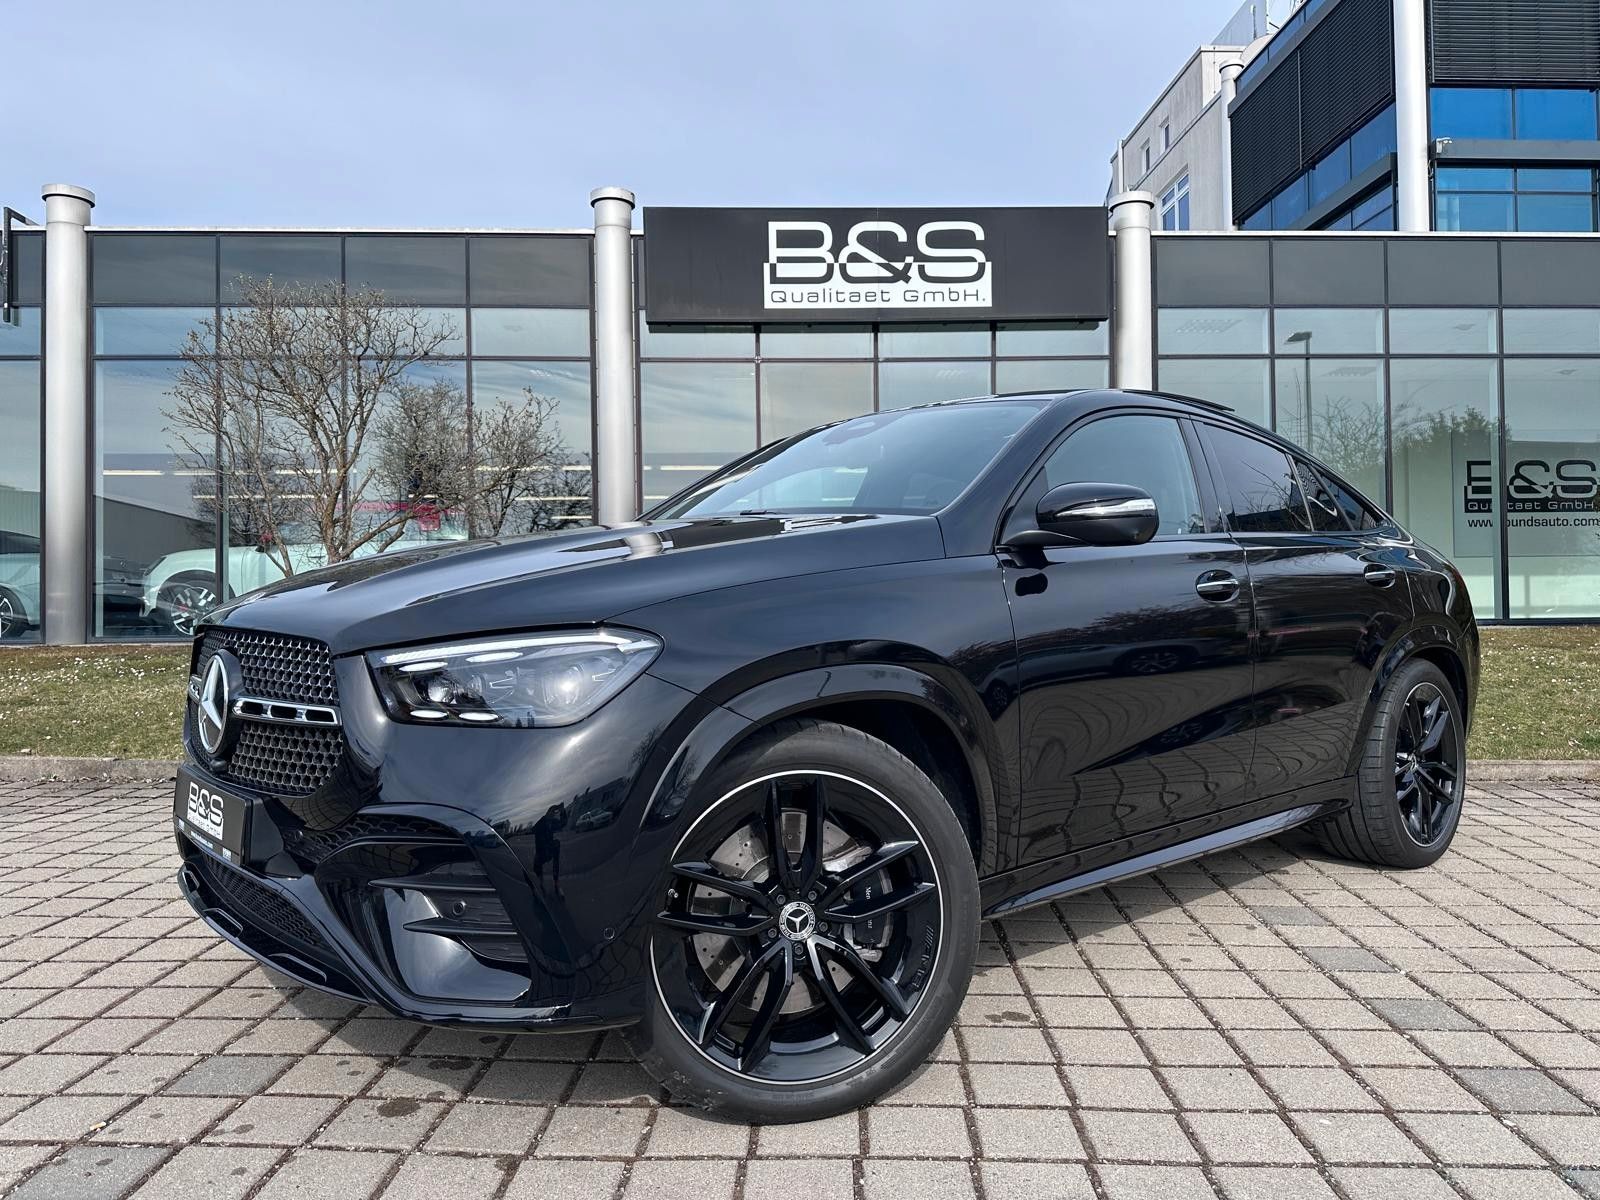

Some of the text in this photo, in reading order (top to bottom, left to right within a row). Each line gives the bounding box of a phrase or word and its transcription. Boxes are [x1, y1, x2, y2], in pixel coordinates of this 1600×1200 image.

[768, 221, 986, 284] B&S
[770, 287, 986, 303] Qualitaet GmbH.
[1467, 502, 1541, 510] Qutaet
[187, 781, 224, 827] B&S
